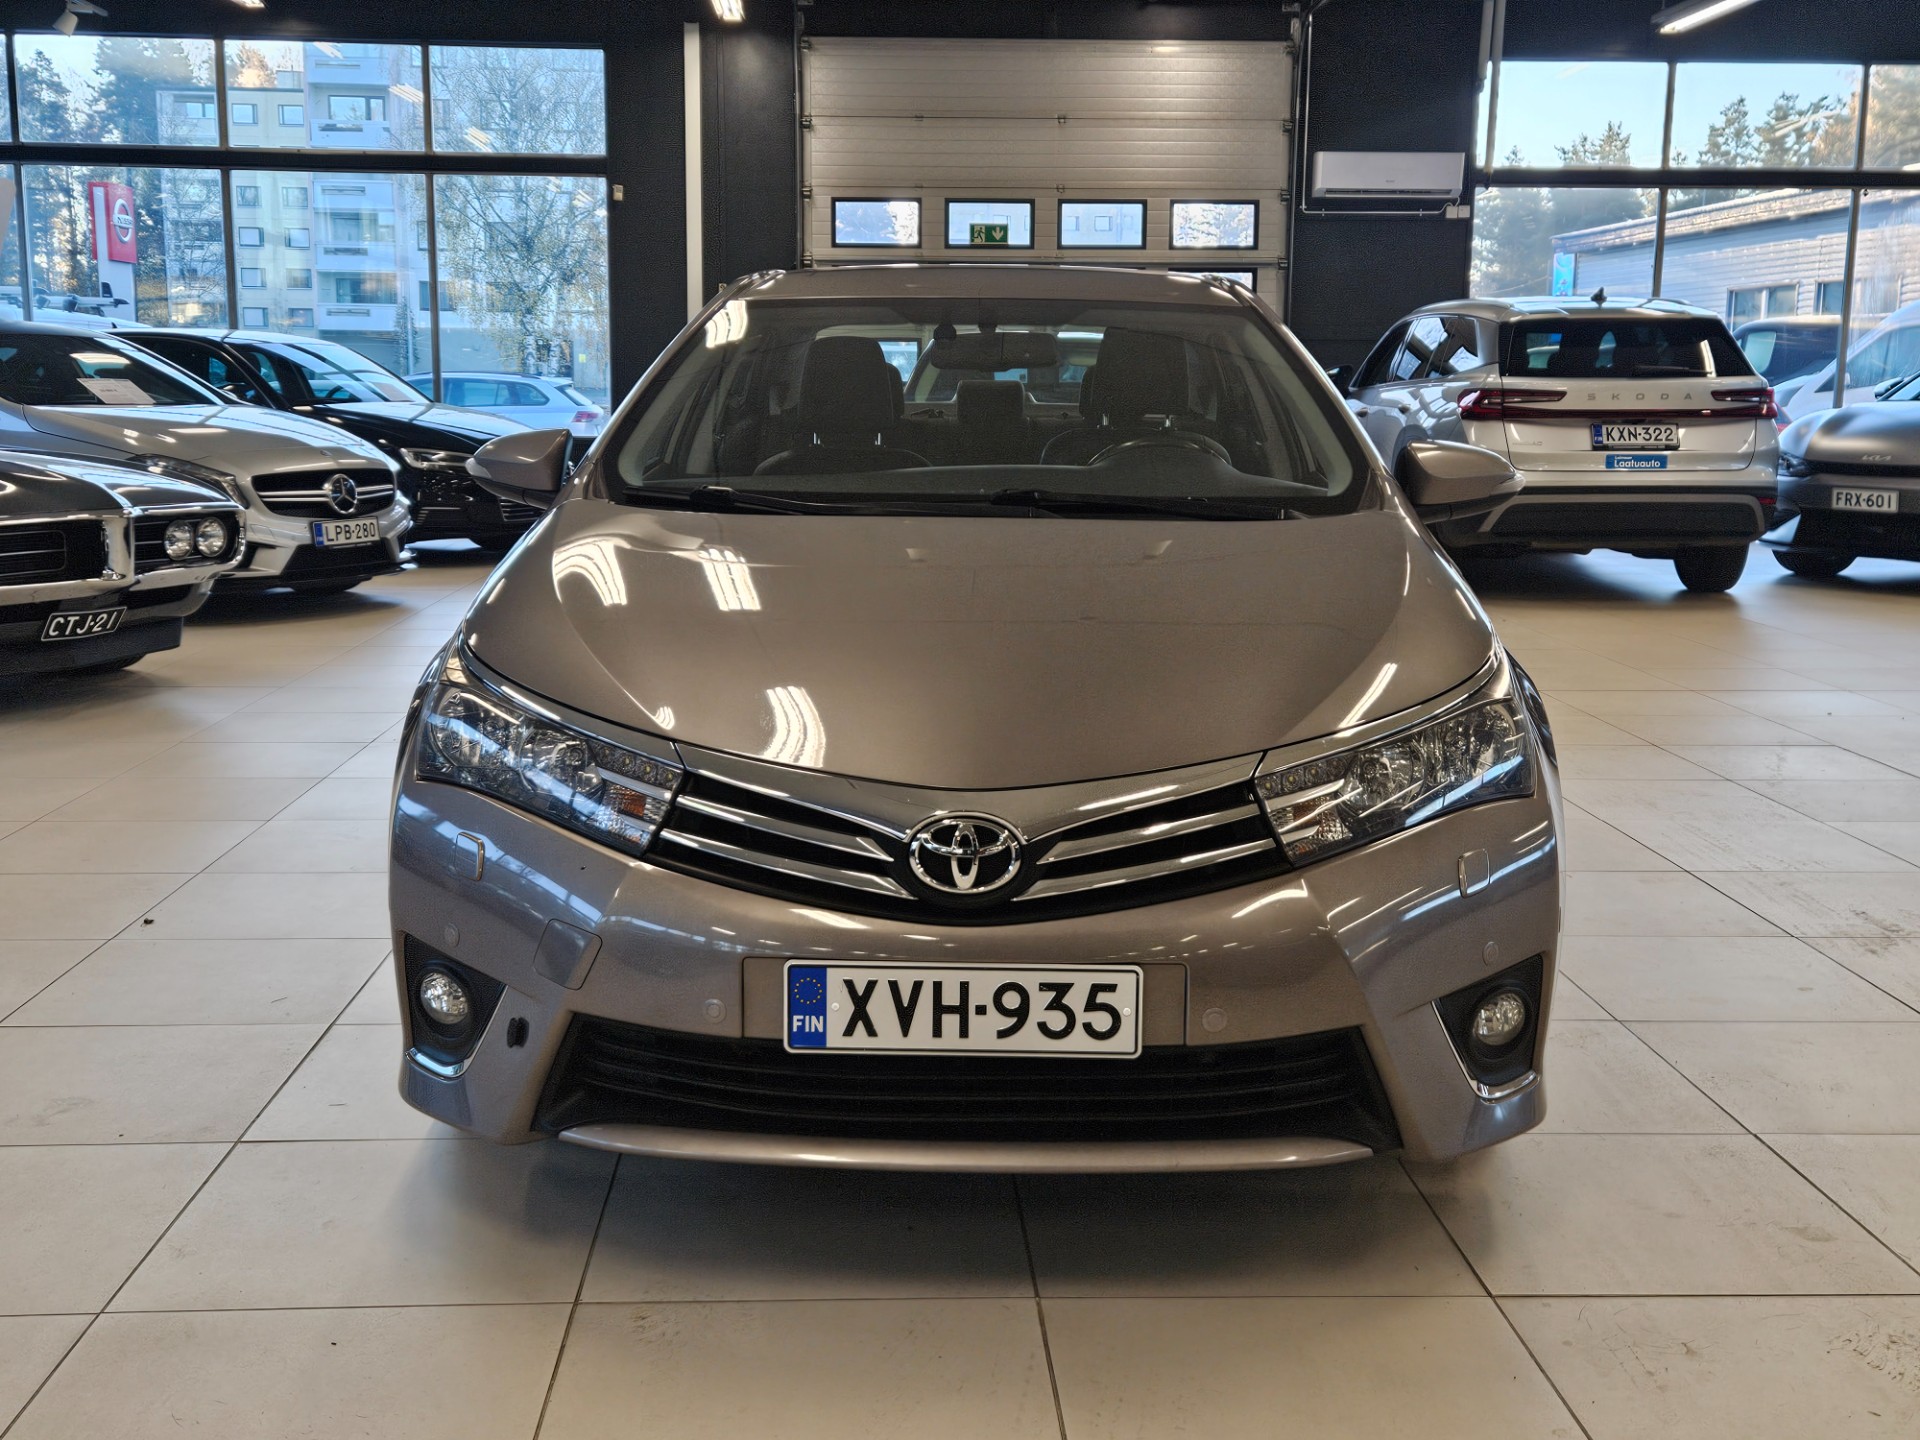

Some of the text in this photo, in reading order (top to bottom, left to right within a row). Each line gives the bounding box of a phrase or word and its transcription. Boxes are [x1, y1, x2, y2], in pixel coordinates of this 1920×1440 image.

[1606, 426, 1674, 442] KXN-322
[1614, 459, 1661, 468] Laatuauto
[1835, 491, 1892, 509] FRX-601
[324, 521, 376, 542] LPB-280
[48, 611, 117, 636] CTJ-21
[792, 978, 1122, 1042] FIN XVH-935
